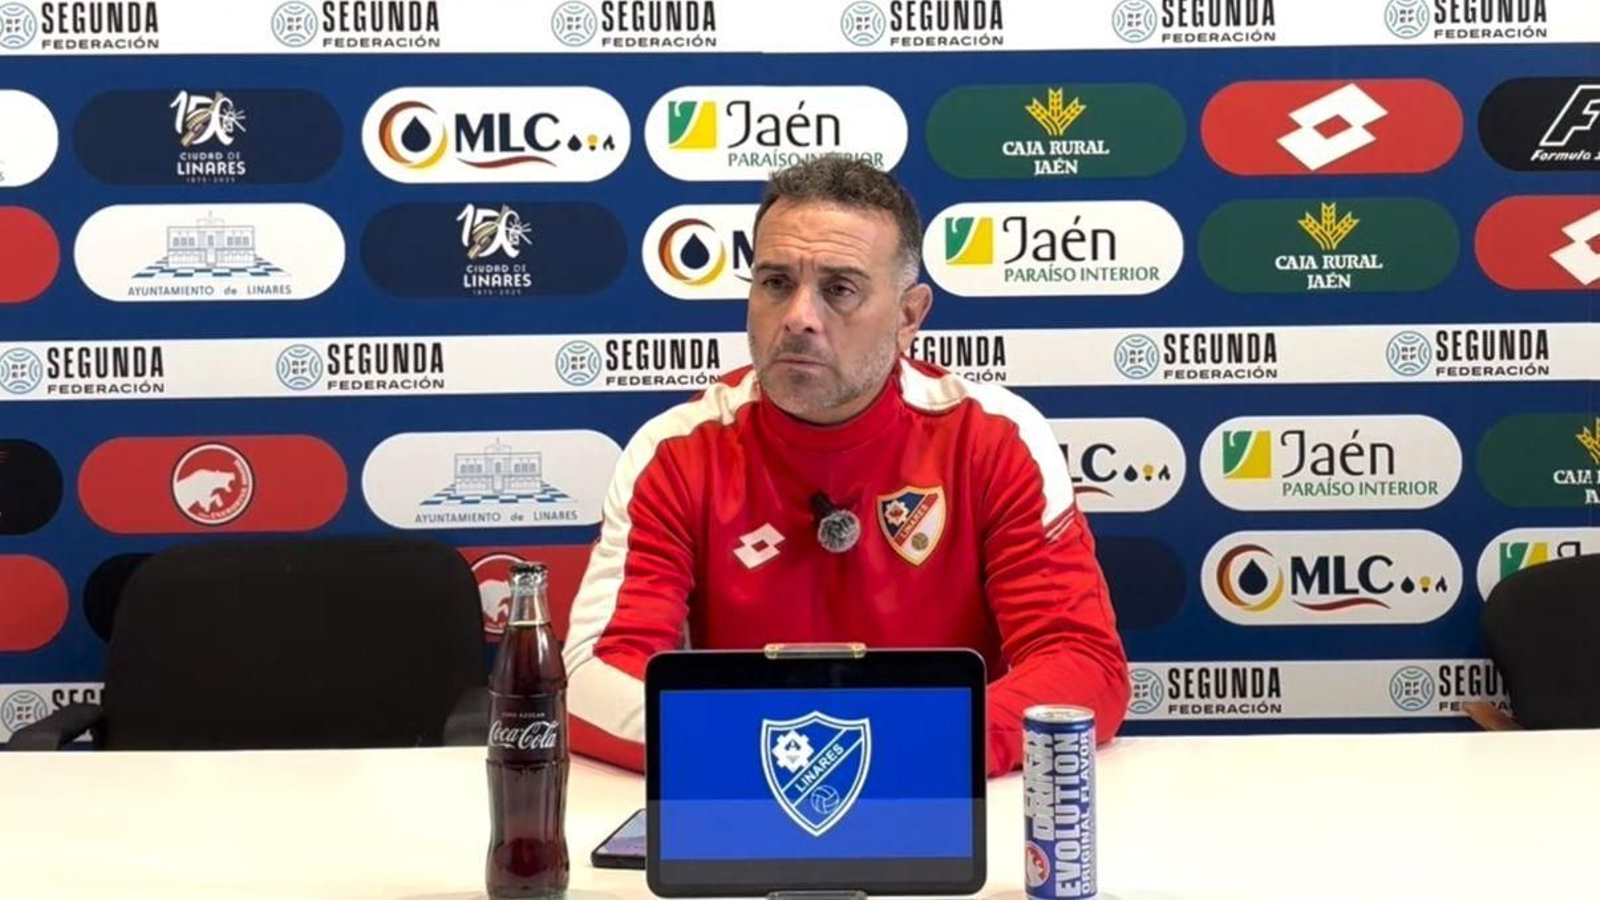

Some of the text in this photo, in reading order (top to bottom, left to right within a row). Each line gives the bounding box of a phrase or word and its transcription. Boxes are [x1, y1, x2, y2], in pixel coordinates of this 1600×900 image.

[42, 2, 158, 34] SEGUNDA
[323, 1, 439, 32] SEGUNDA
[602, 0, 716, 32] SEGUNDA
[890, 0, 1003, 31] SEGUNDA
[1162, 0, 1275, 28] SEGUNDA
[1434, 0, 1546, 24] SEGUNDA
[890, 33, 1003, 47] FEDERACIÓN
[1162, 30, 1275, 43] FEDERACIÓN
[1434, 23, 1547, 39] FEDERACIÓN
[42, 36, 159, 49] FEDERACIÓN
[323, 35, 440, 48] FEDERACIÓN
[602, 34, 716, 47] FEDERACIÓN
[455, 113, 561, 152] MLC
[726, 101, 840, 148] Jaén
[180, 152, 240, 160] CIUDAD DE
[1002, 140, 1110, 156] CAJA RURAL
[1531, 149, 1591, 161] Formula
[728, 149, 800, 167] PARAÍSO
[1035, 158, 1078, 175] JAÉN
[178, 161, 245, 175] LINARES
[1003, 215, 1115, 264] Jaén
[465, 264, 527, 274] CIUDAD DE
[1275, 254, 1383, 270] CAJA RURAL
[464, 272, 531, 287] LINARES
[1005, 264, 1160, 282] PARAÍSO INTERIOR
[1307, 272, 1351, 289] JAÉN
[128, 285, 292, 296] AYUNTAMIENTO de LINARES
[910, 334, 1007, 367] EGUNDA
[1164, 333, 1277, 365] SEGUNDA
[1436, 329, 1548, 361] SEGUNDA
[47, 346, 163, 378] SEGUNDA
[328, 342, 444, 375] SEGUNDA
[606, 338, 720, 371] SEGUNDA
[1164, 364, 1277, 379] FEDERACIÓN
[1436, 361, 1549, 376] FEDERACIÓN
[48, 380, 164, 394] FEDERACIÓN
[328, 376, 444, 390] FEDERACIÓN
[606, 372, 720, 386] FEDERACIÓN
[1058, 443, 1118, 483] LC
[1281, 430, 1394, 478] Jaén
[1282, 475, 1438, 496] PARAÍSO INTERIOR
[1553, 470, 1592, 484] CAJA
[415, 510, 578, 523] AYUNTAMIENTO de LINARES
[1291, 555, 1394, 595] MLC
[1168, 667, 1281, 698] SEGUNDA
[1168, 699, 1281, 714] FEDERACIÓN
[488, 720, 559, 751] Coca-Cola
[794, 741, 845, 794] LINARES
[1054, 732, 1081, 897] EVOLUTION
[1079, 730, 1091, 896] ORIGINAL FLAVOR
